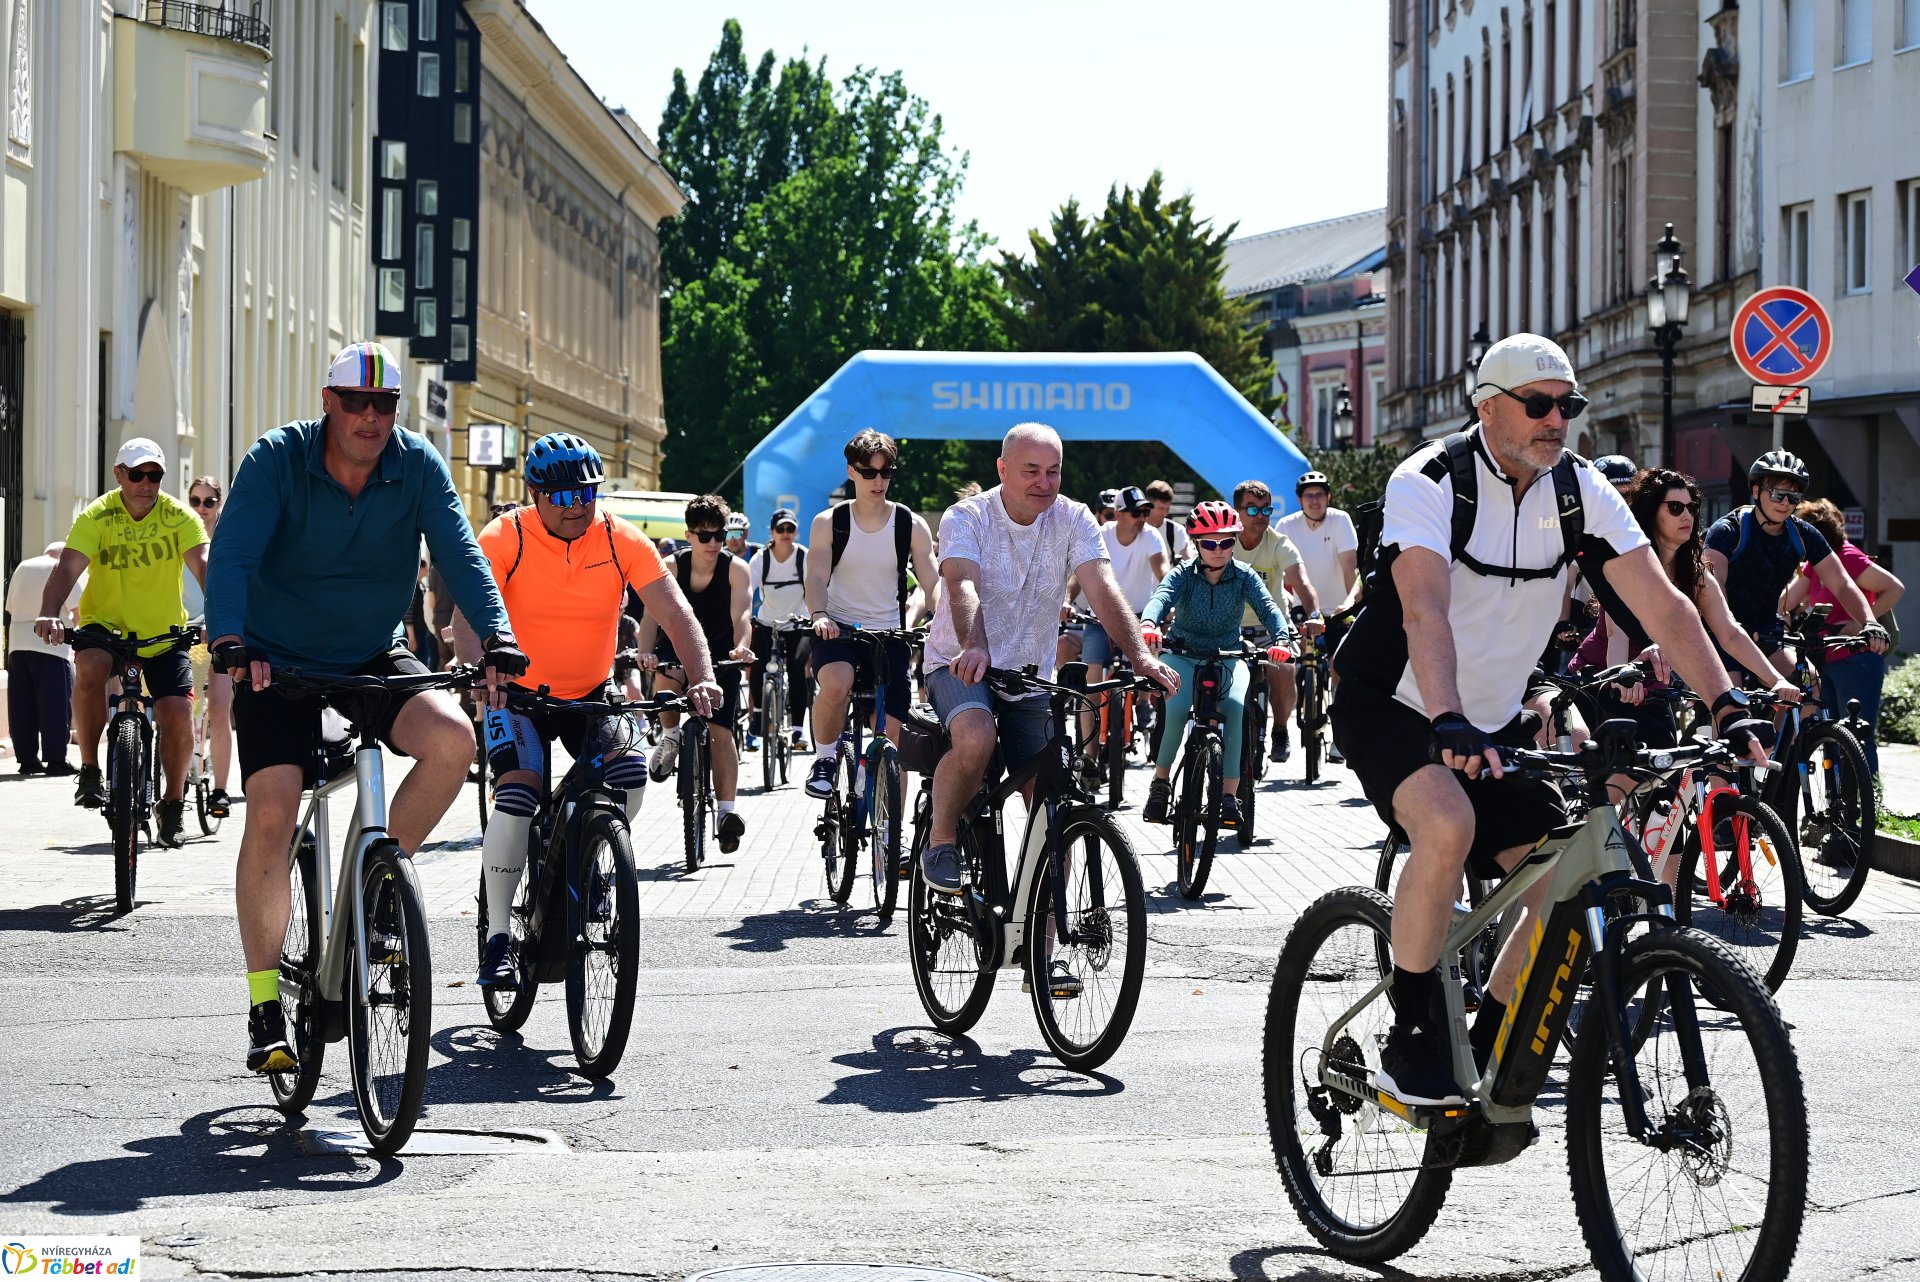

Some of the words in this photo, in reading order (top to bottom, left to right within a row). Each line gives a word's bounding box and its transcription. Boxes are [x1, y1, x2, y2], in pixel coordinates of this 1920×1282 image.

[932, 382, 1131, 411] SHIMANO
[490, 865, 521, 874] ITALIA
[1531, 928, 1582, 1056] FUJI
[1282, 1156, 1308, 1207] SMART
[1308, 1210, 1329, 1232] SAM
